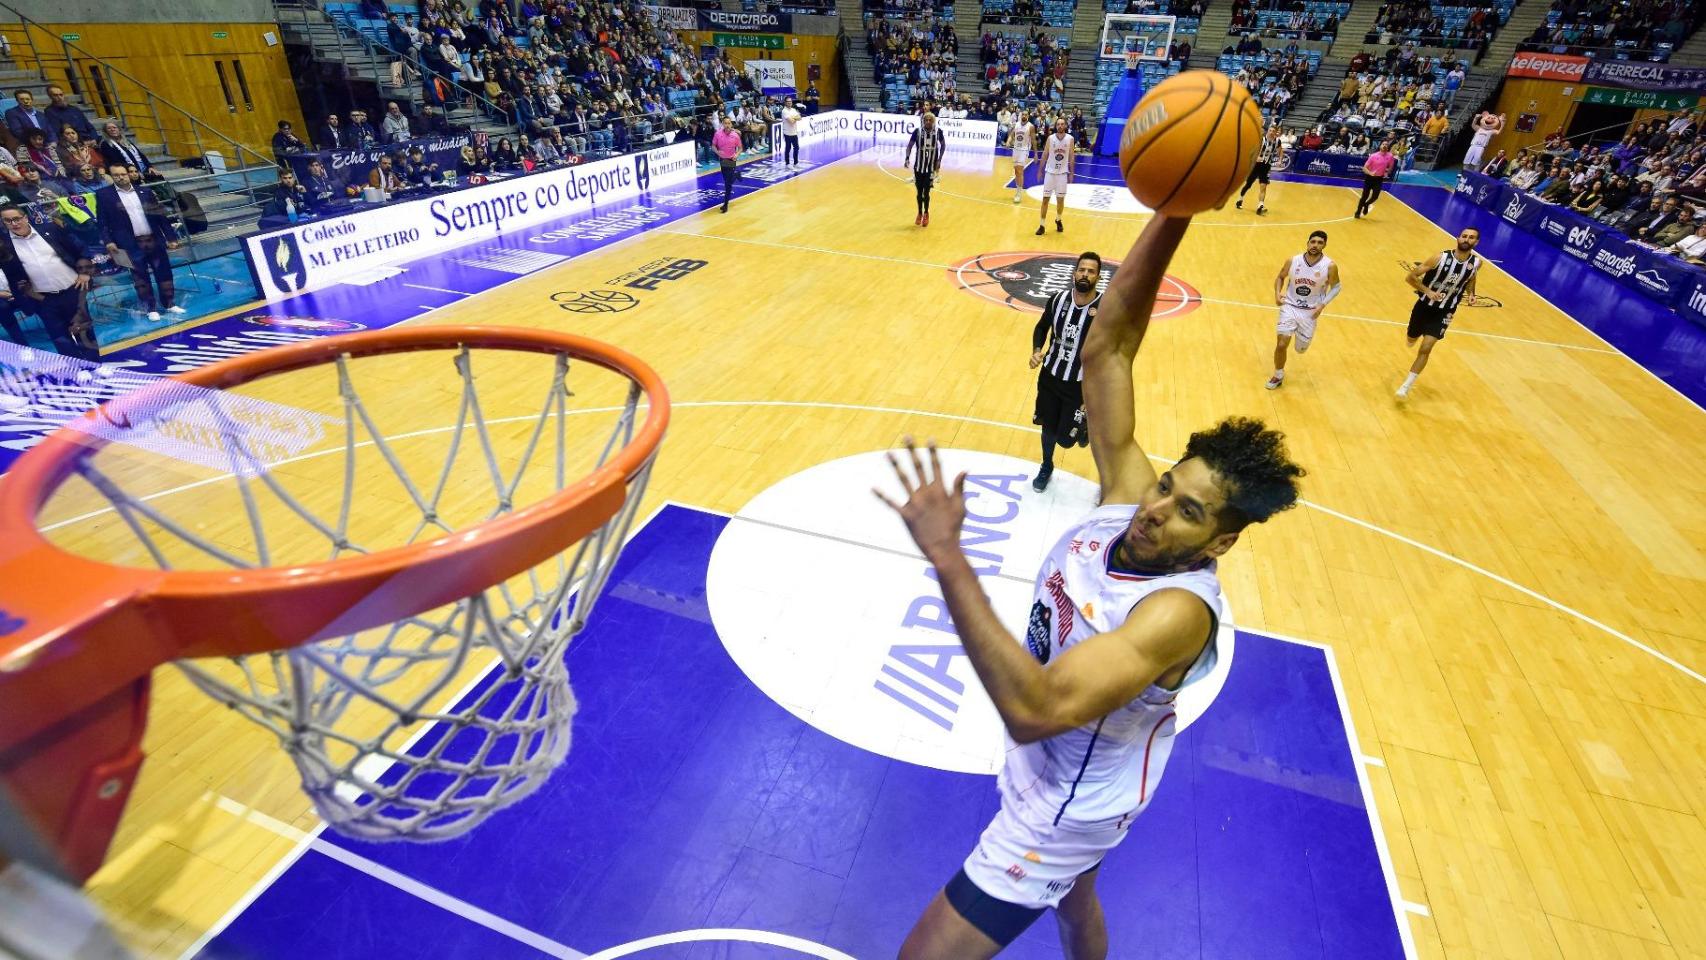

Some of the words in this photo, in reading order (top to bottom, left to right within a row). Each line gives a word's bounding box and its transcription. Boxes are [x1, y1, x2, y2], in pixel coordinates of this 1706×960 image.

[1511, 56, 1587, 76] telepizza
[1602, 63, 1664, 81] FERRECAL
[854, 113, 915, 138] deporte
[332, 151, 366, 169] Eche
[430, 190, 527, 237] Sempre
[535, 184, 560, 209] co
[566, 164, 631, 204] deporte
[302, 219, 356, 244] Colexio
[309, 252, 331, 269] M.
[333, 227, 420, 263] PELETEIRO
[624, 258, 709, 291] FEB
[1026, 262, 1076, 299] Estrella
